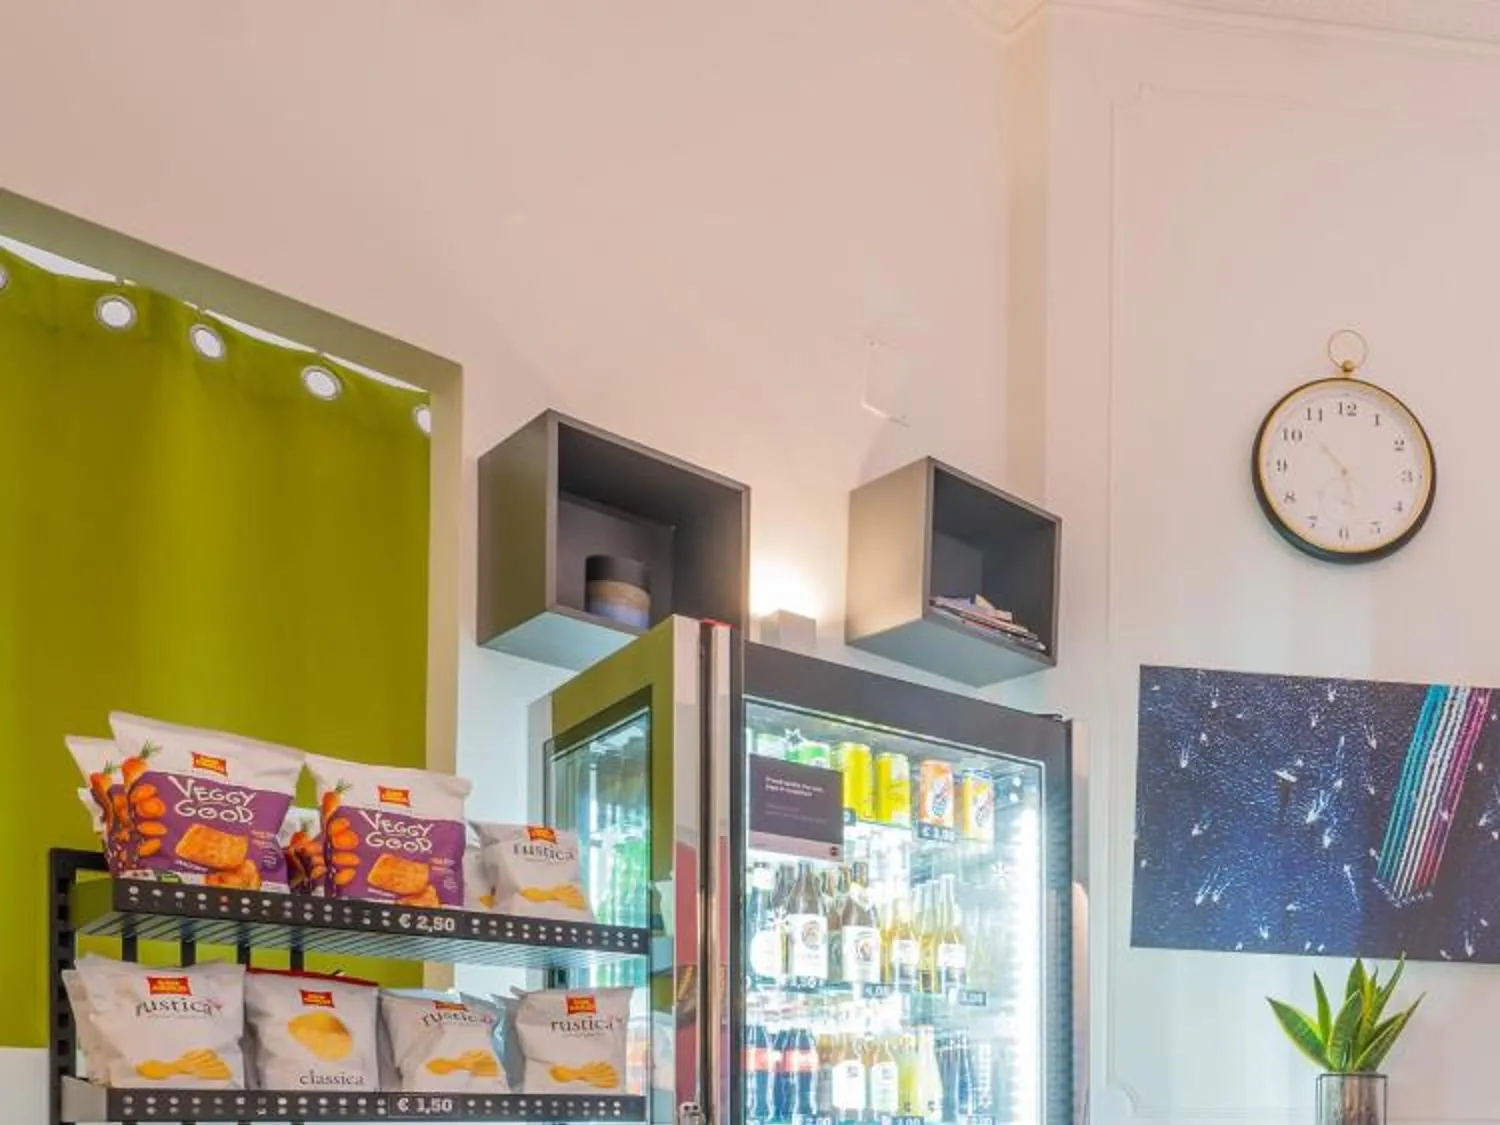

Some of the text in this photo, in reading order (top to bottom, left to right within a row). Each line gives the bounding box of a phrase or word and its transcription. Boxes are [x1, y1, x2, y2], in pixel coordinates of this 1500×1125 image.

[1306, 407, 1323, 423] 11
[1337, 401, 1357, 416] 12
[1373, 414, 1380, 426] 1
[1282, 428, 1303, 442] 10
[1276, 459, 1288, 472] 9
[1402, 470, 1413, 482] 3
[166, 775, 256, 806] VEGGY
[174, 799, 255, 823] GOOD
[360, 810, 434, 837] VEGGY
[364, 833, 433, 853] GOOD
[399, 914, 456, 932] € 2,50
[298, 1070, 365, 1086] classica
[397, 1097, 453, 1115] € 1,50
